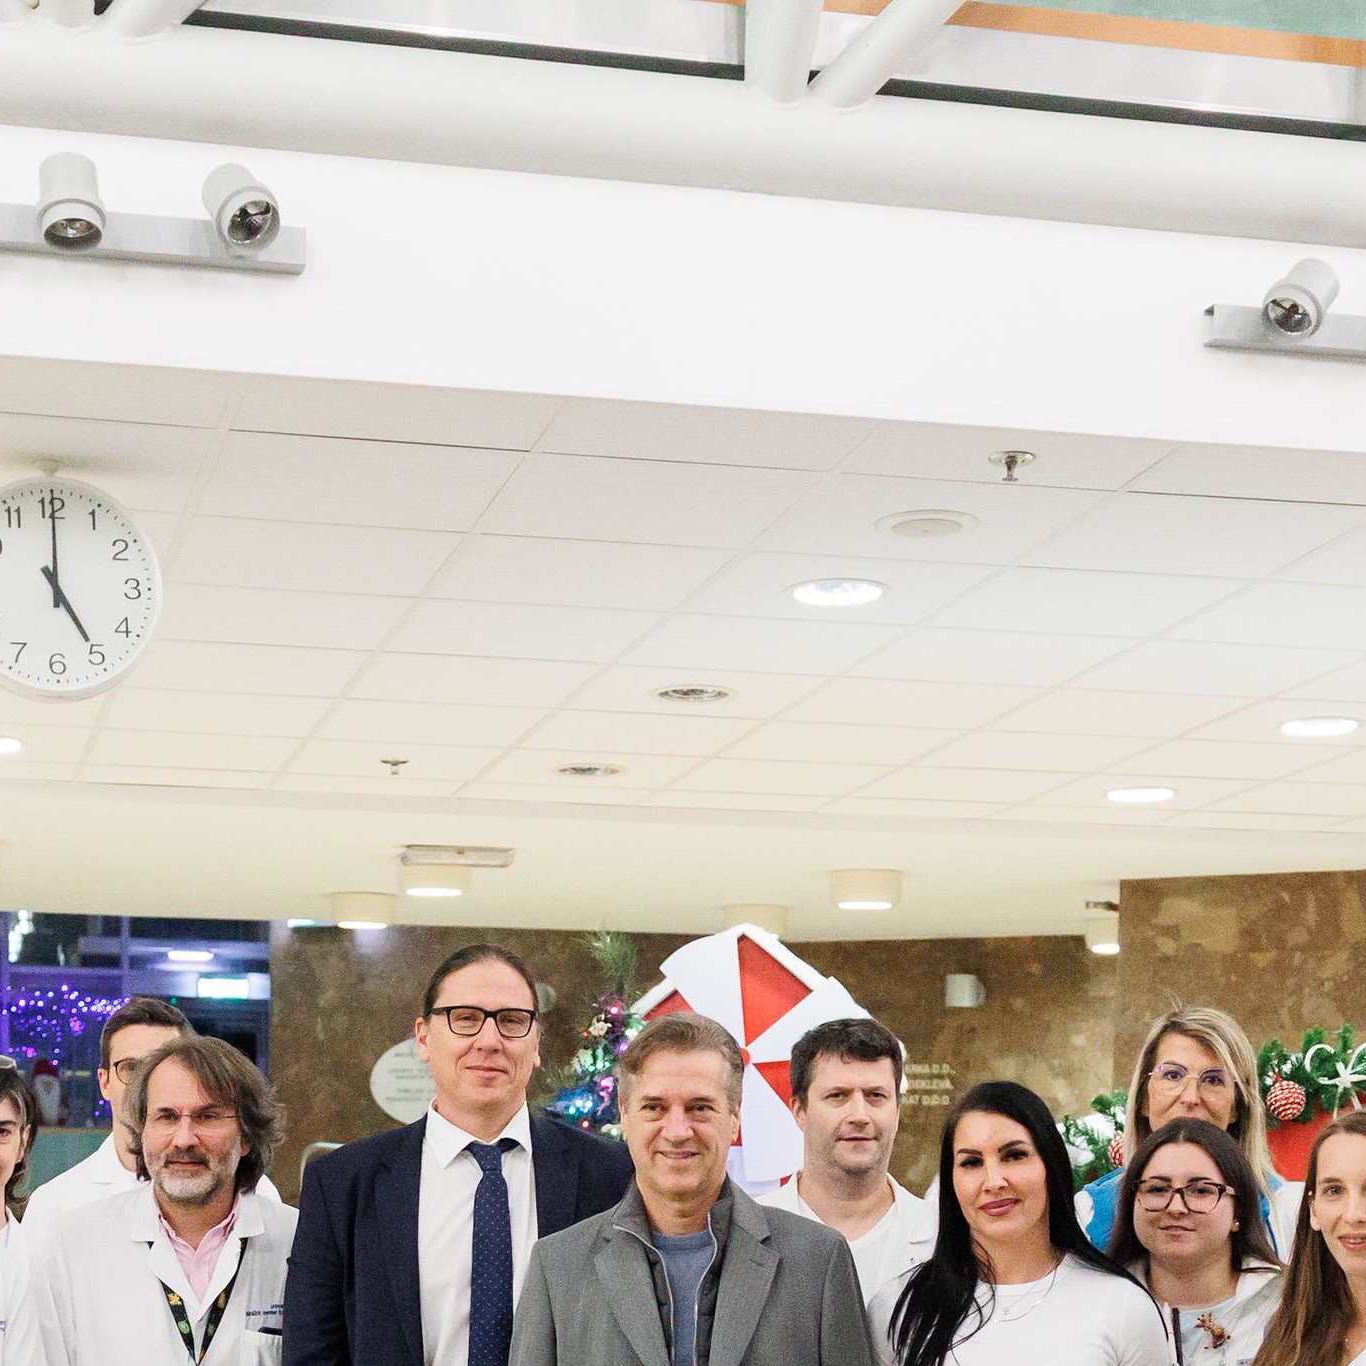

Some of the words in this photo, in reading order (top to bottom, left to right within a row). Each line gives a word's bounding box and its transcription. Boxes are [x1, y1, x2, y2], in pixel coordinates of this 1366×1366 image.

[4, 505, 22, 528] 11
[37, 496, 66, 519] 12
[88, 508, 96, 530] 1
[111, 538, 129, 561] 2
[123, 577, 142, 600] 3
[114, 616, 133, 638] 4
[10, 641, 27, 664] 7
[48, 652, 67, 675] 6
[87, 643, 105, 666] 5
